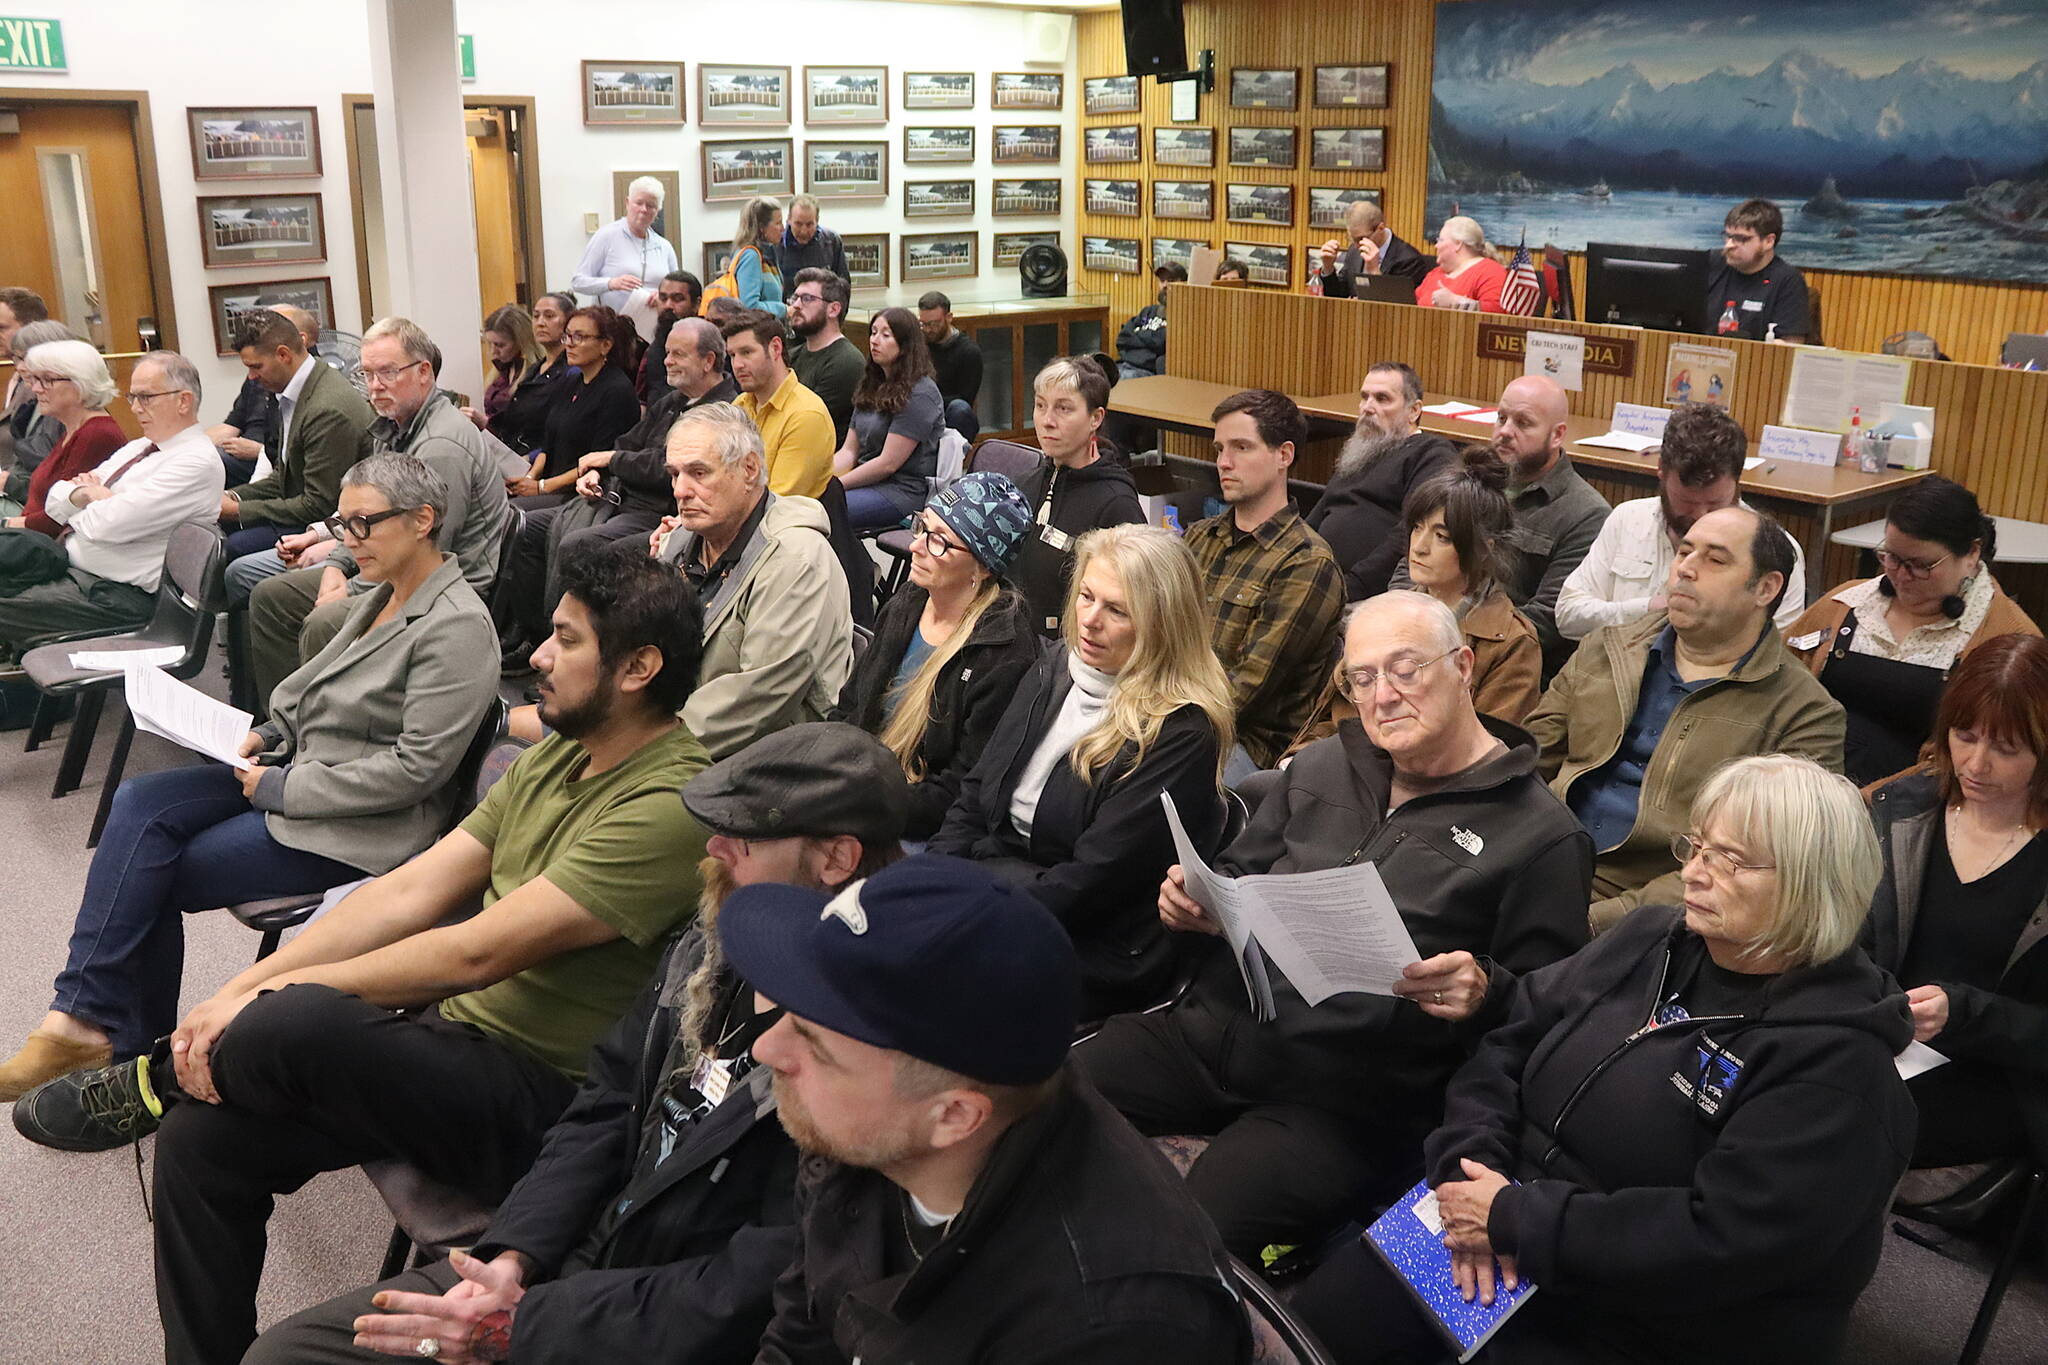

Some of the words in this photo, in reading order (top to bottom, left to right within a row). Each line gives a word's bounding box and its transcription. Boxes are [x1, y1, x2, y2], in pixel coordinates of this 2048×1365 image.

[1544, 340, 1559, 349] TECH
[1560, 343, 1578, 351] STAFF
[1450, 825, 1474, 846] NORTH
